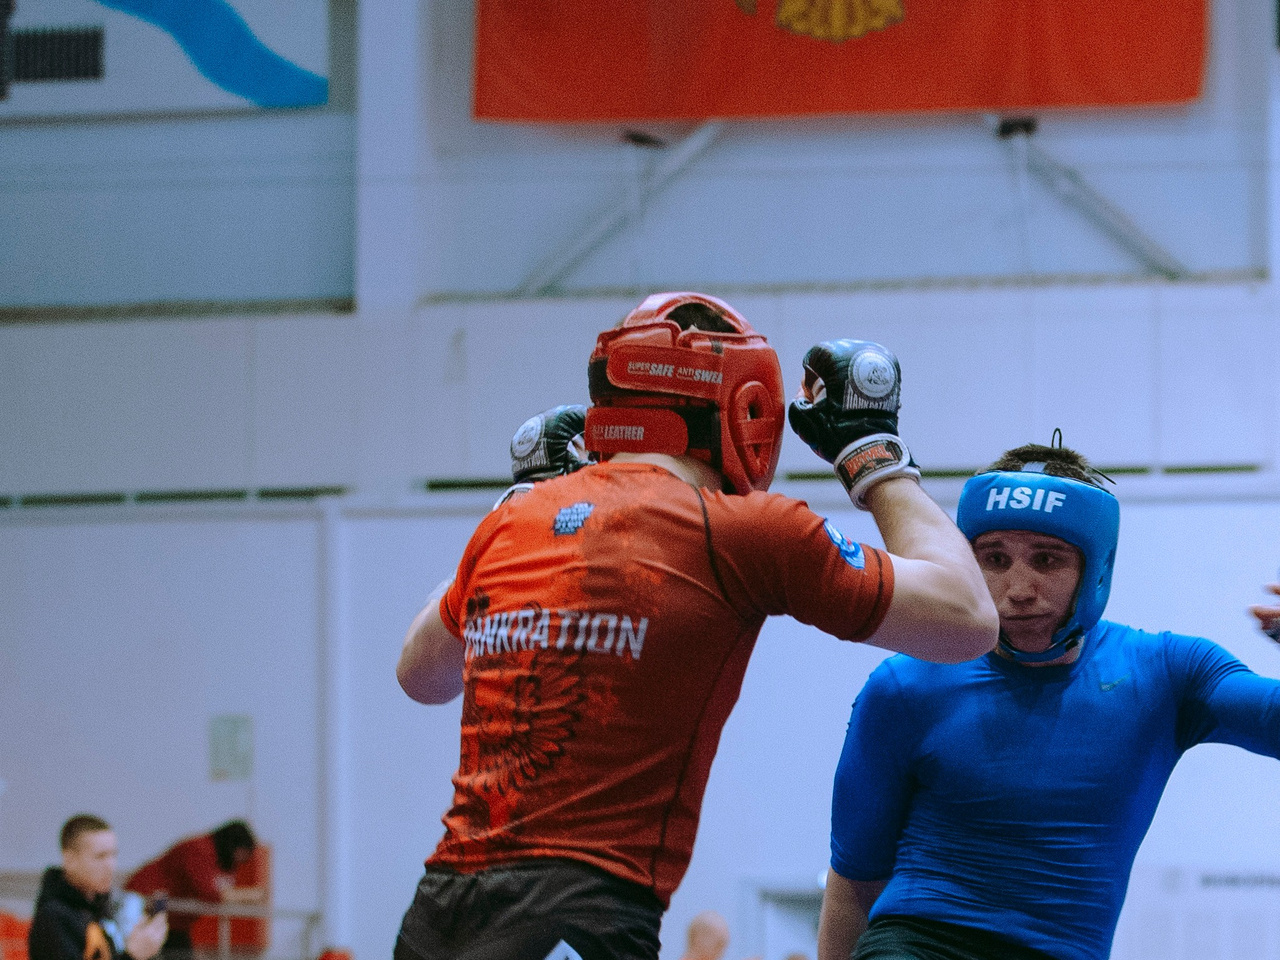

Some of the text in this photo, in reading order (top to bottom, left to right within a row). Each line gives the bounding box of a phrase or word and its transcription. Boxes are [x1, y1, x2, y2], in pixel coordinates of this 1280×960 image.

[649, 363, 675, 378] SAFE
[604, 425, 645, 441] LEATHER
[985, 486, 1067, 513] HSIF
